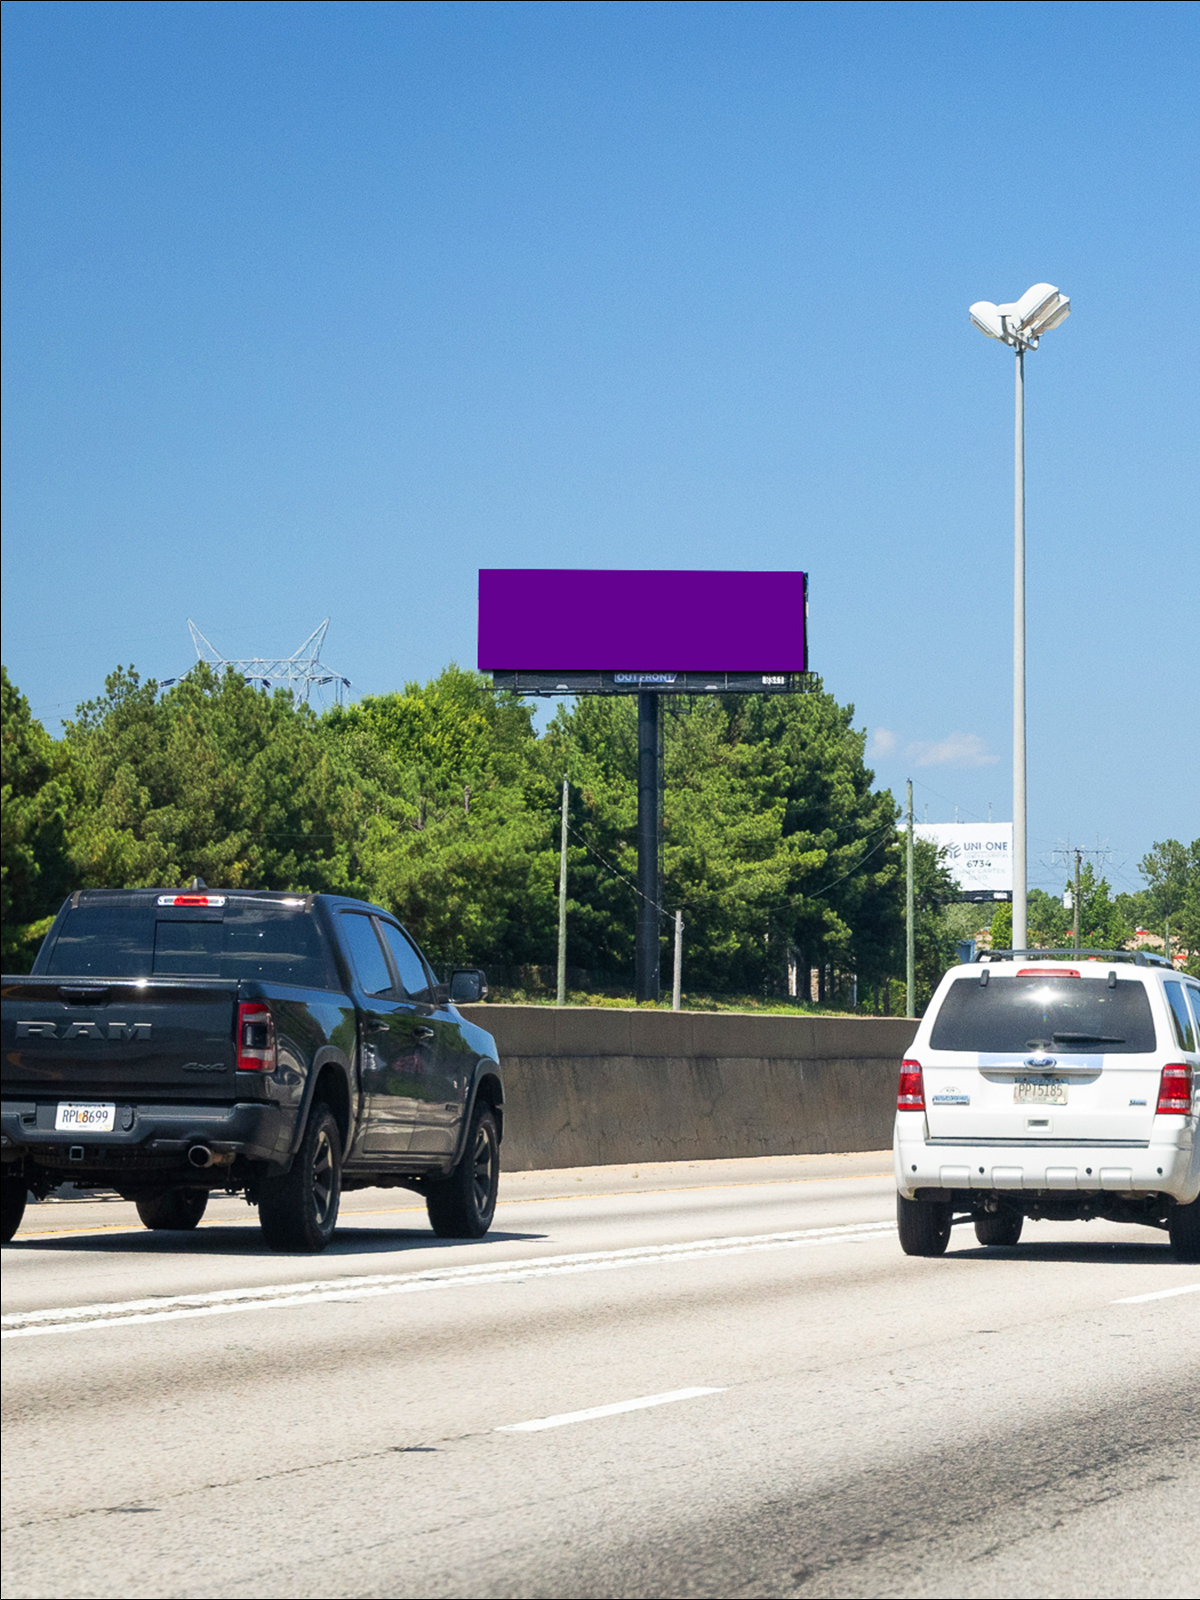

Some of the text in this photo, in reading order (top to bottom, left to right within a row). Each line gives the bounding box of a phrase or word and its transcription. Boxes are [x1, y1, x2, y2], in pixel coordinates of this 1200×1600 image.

[963, 841, 1008, 851] UNI ONE
[966, 860, 992, 868] 6734
[15, 1021, 153, 1041] RAM
[181, 1061, 228, 1072] 4x4
[62, 1109, 109, 1124] RPL8699
